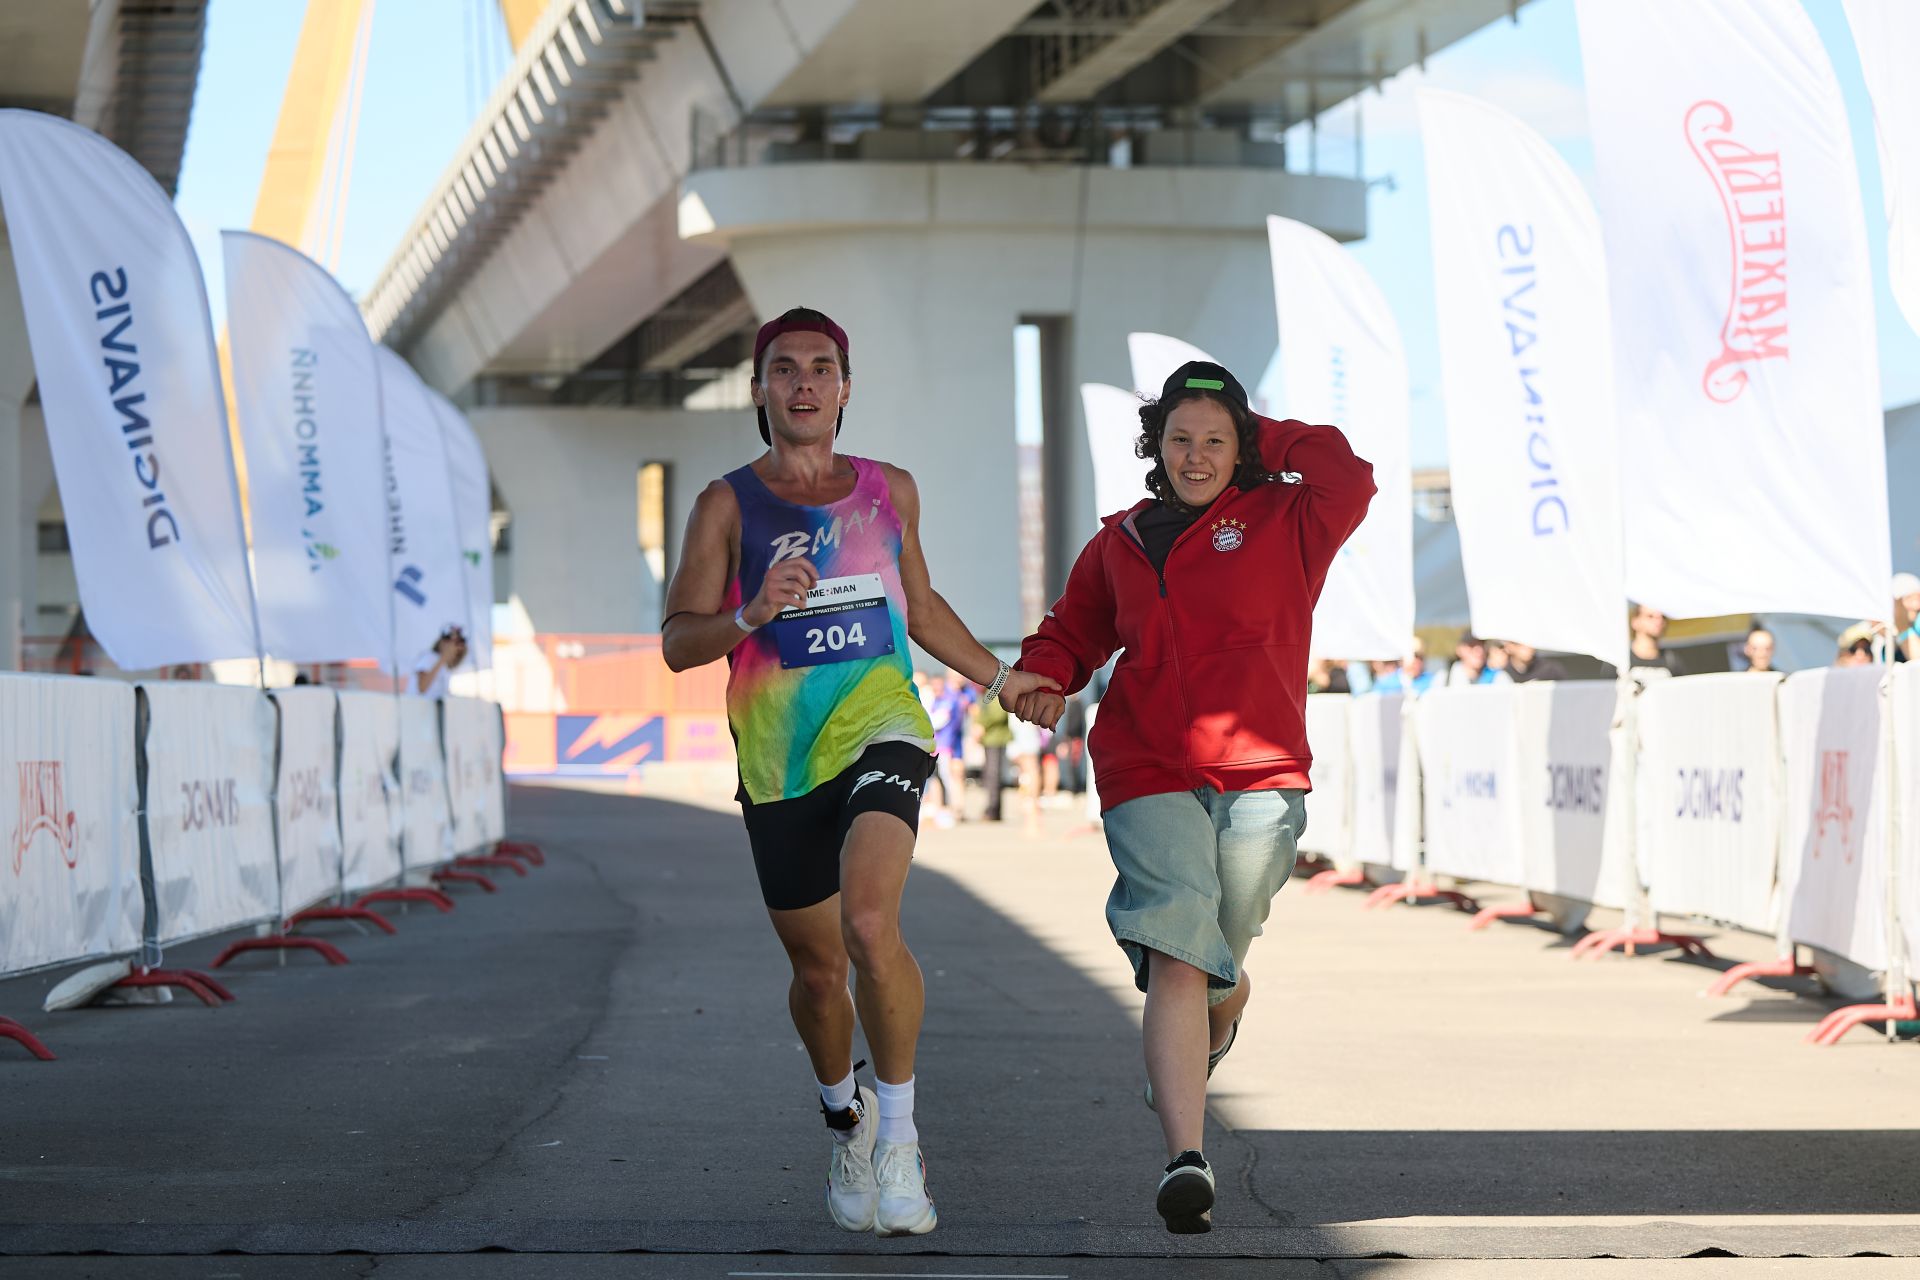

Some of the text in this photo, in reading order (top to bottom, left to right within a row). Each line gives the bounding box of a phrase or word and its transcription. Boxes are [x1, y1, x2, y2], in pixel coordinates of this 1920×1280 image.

[782, 609, 814, 620] КАЗАНСКИЙ
[814, 606, 842, 615] ТРИАТЛОН
[806, 622, 867, 654] 204
